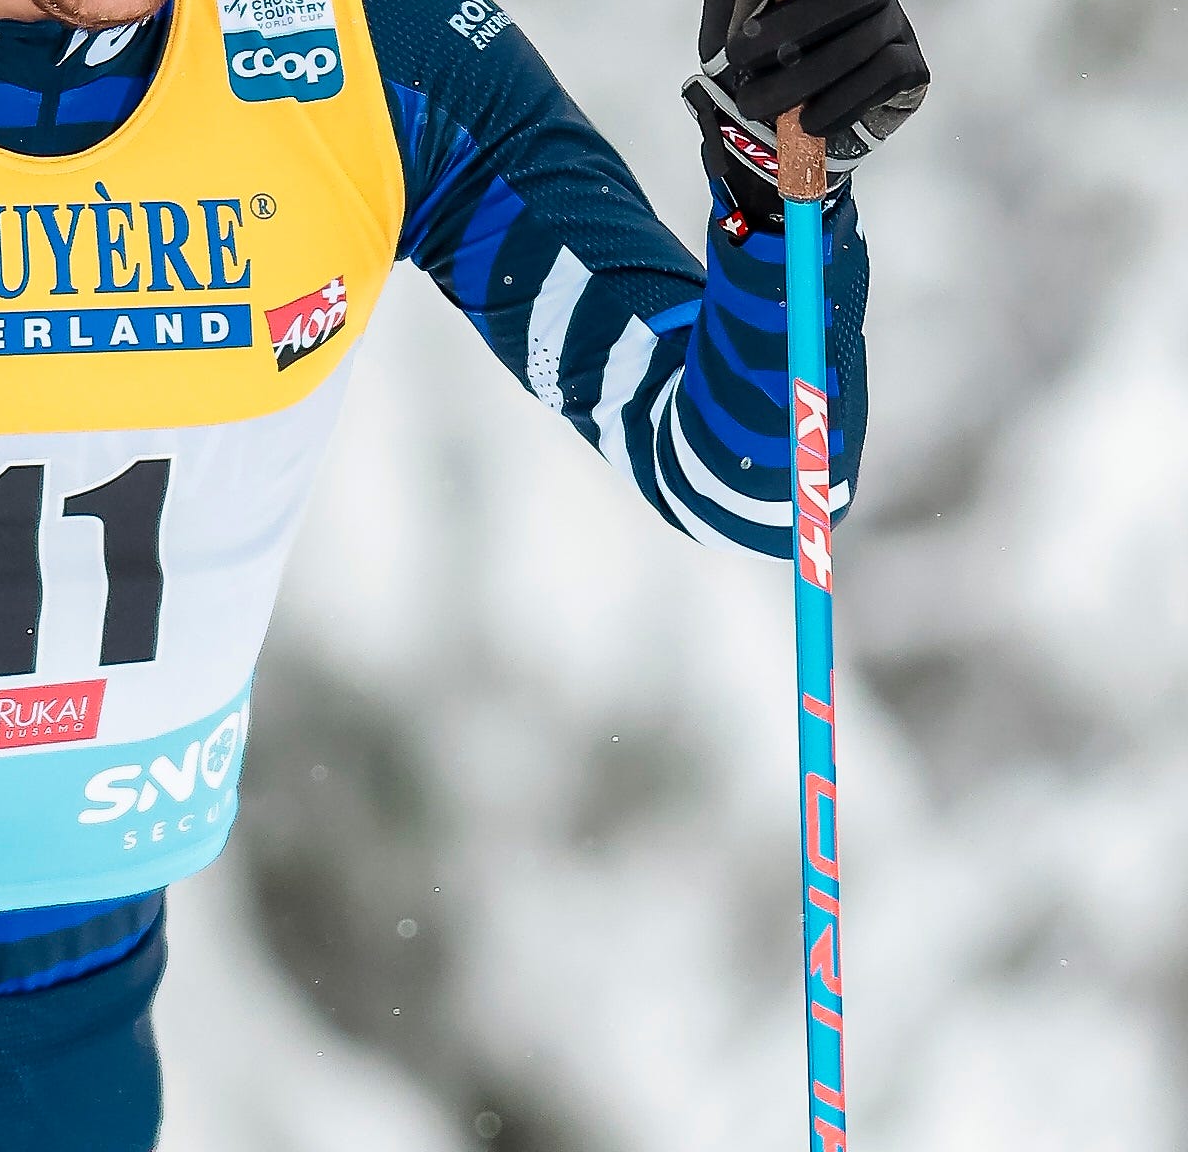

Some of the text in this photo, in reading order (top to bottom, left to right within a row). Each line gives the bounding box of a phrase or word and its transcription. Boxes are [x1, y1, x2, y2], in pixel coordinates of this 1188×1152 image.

[253, 1, 327, 22] COUNTRY
[300, 12, 324, 23] CUP
[232, 47, 338, 84] coop
[273, 299, 349, 360] AOP
[77, 701, 250, 824] SNO
[122, 789, 236, 850] SECU
